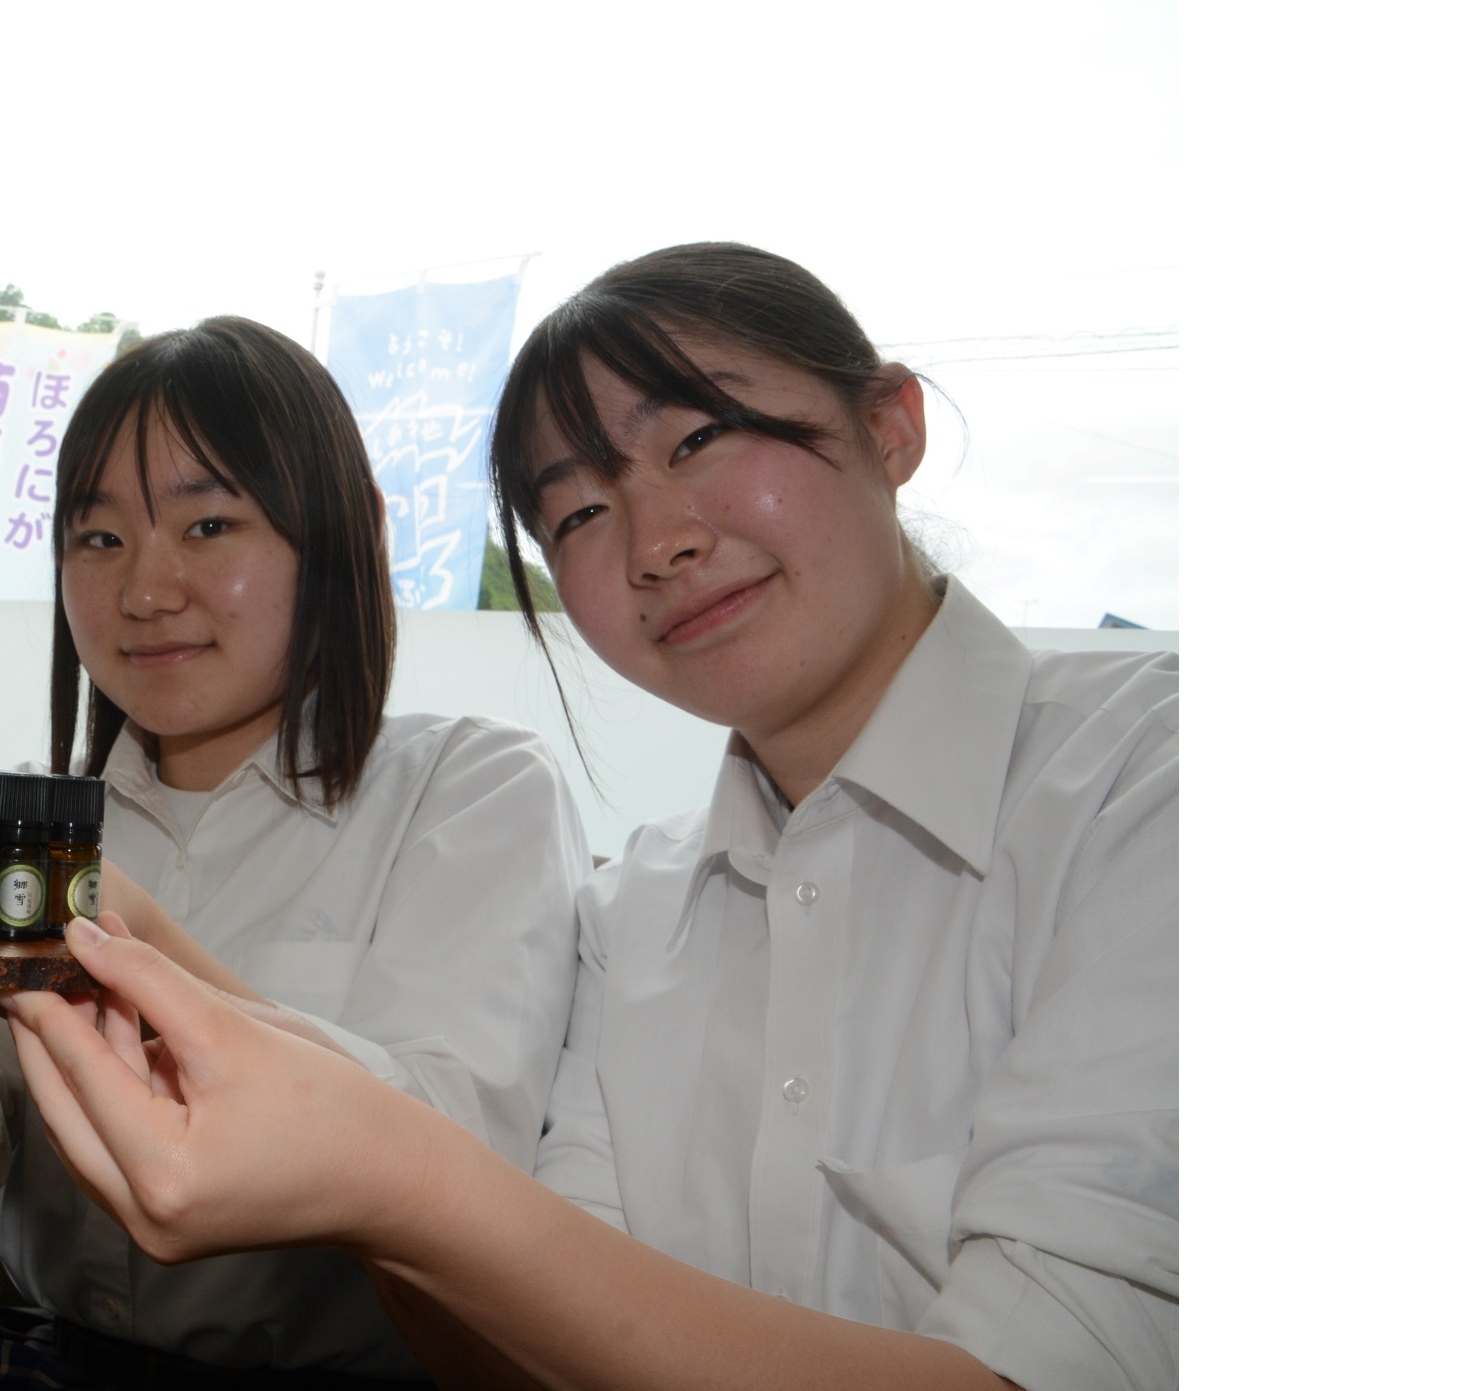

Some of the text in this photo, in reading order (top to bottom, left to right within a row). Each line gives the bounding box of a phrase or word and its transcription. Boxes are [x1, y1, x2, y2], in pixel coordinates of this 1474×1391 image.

[368, 357, 476, 389] Welcome!
[4, 371, 72, 550] ほろにが
